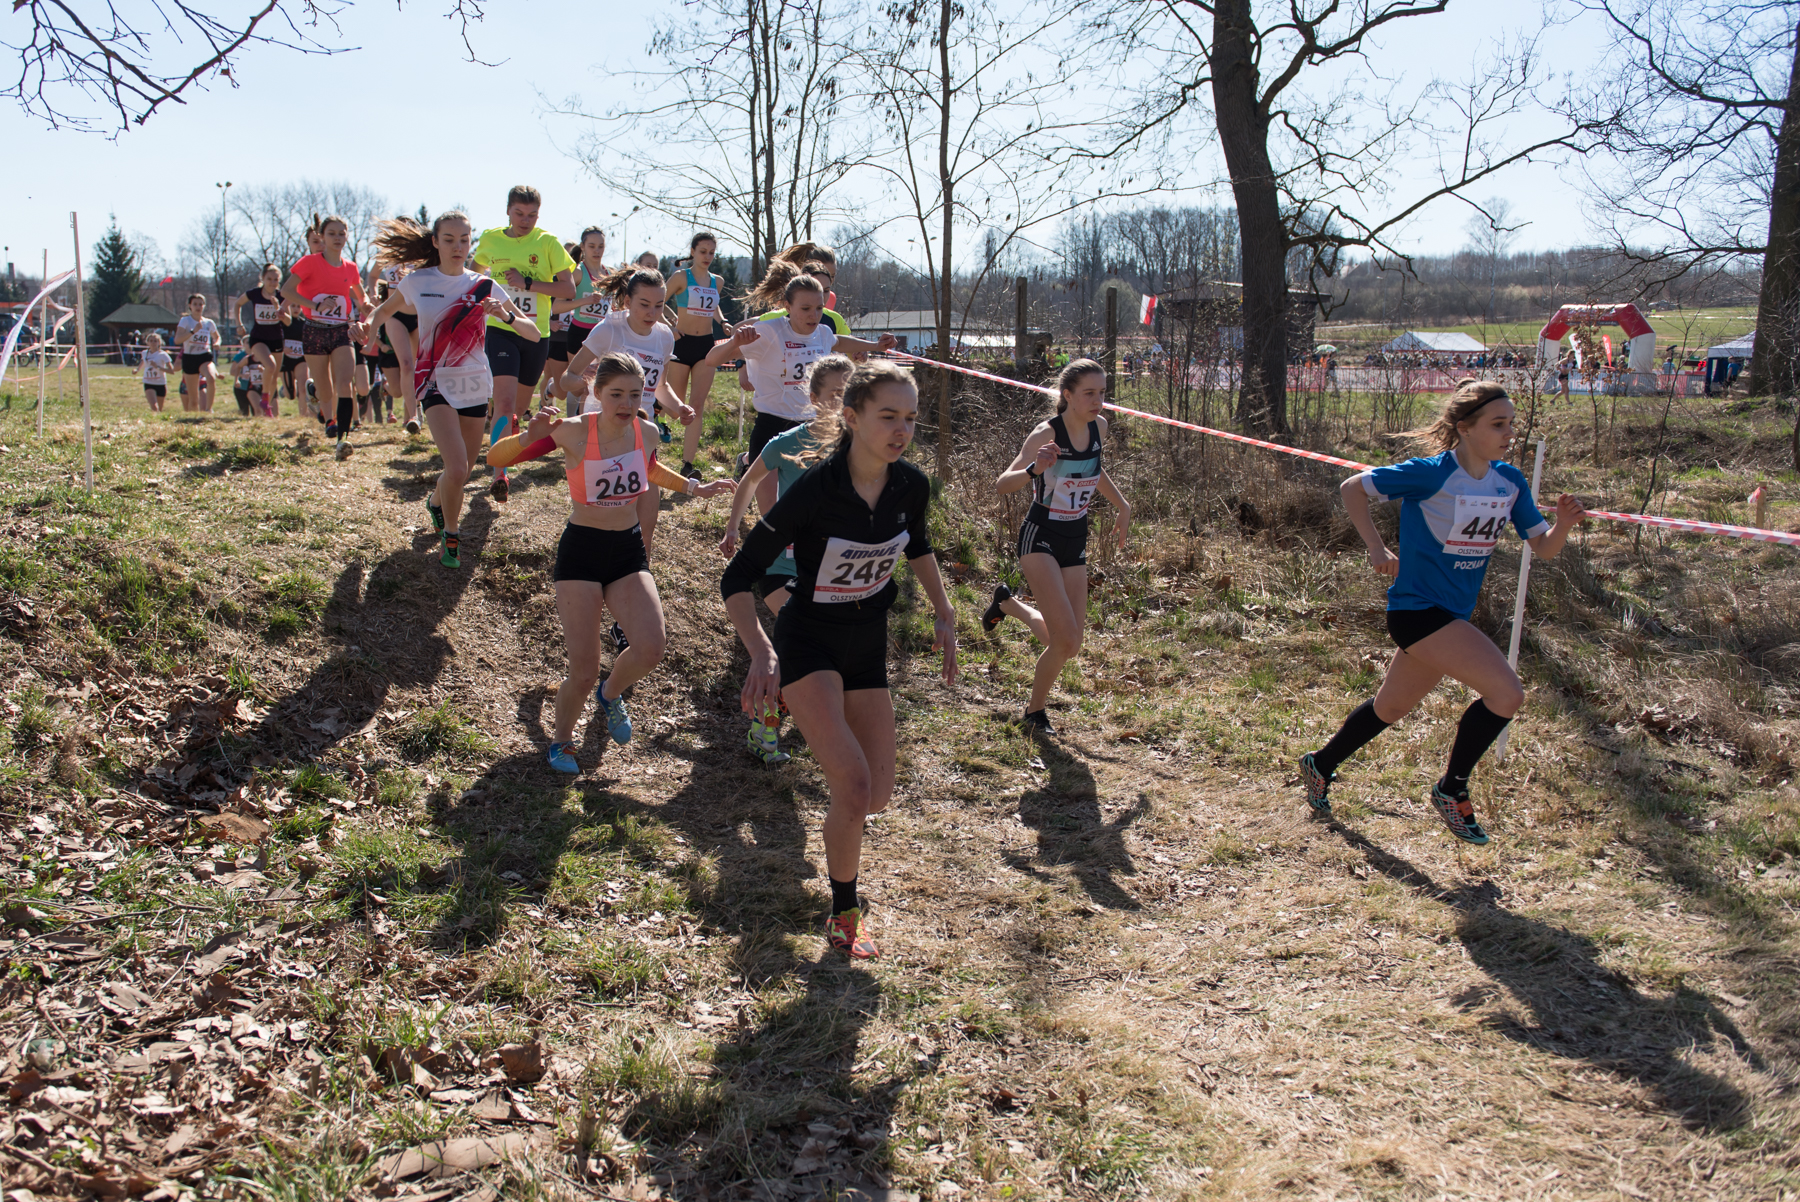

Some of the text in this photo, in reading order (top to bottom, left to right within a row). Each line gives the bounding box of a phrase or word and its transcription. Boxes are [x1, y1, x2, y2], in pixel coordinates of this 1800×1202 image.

[512, 298, 531, 312] 45
[586, 303, 609, 312] 329
[700, 296, 714, 309] 12
[258, 311, 276, 319] 466
[319, 305, 342, 317] 24
[193, 334, 208, 343] 540
[595, 470, 641, 500] 268
[1069, 491, 1090, 509] 15
[1461, 516, 1507, 540] 448
[830, 558, 894, 585] 248
[830, 594, 862, 602] OLSZYNA
